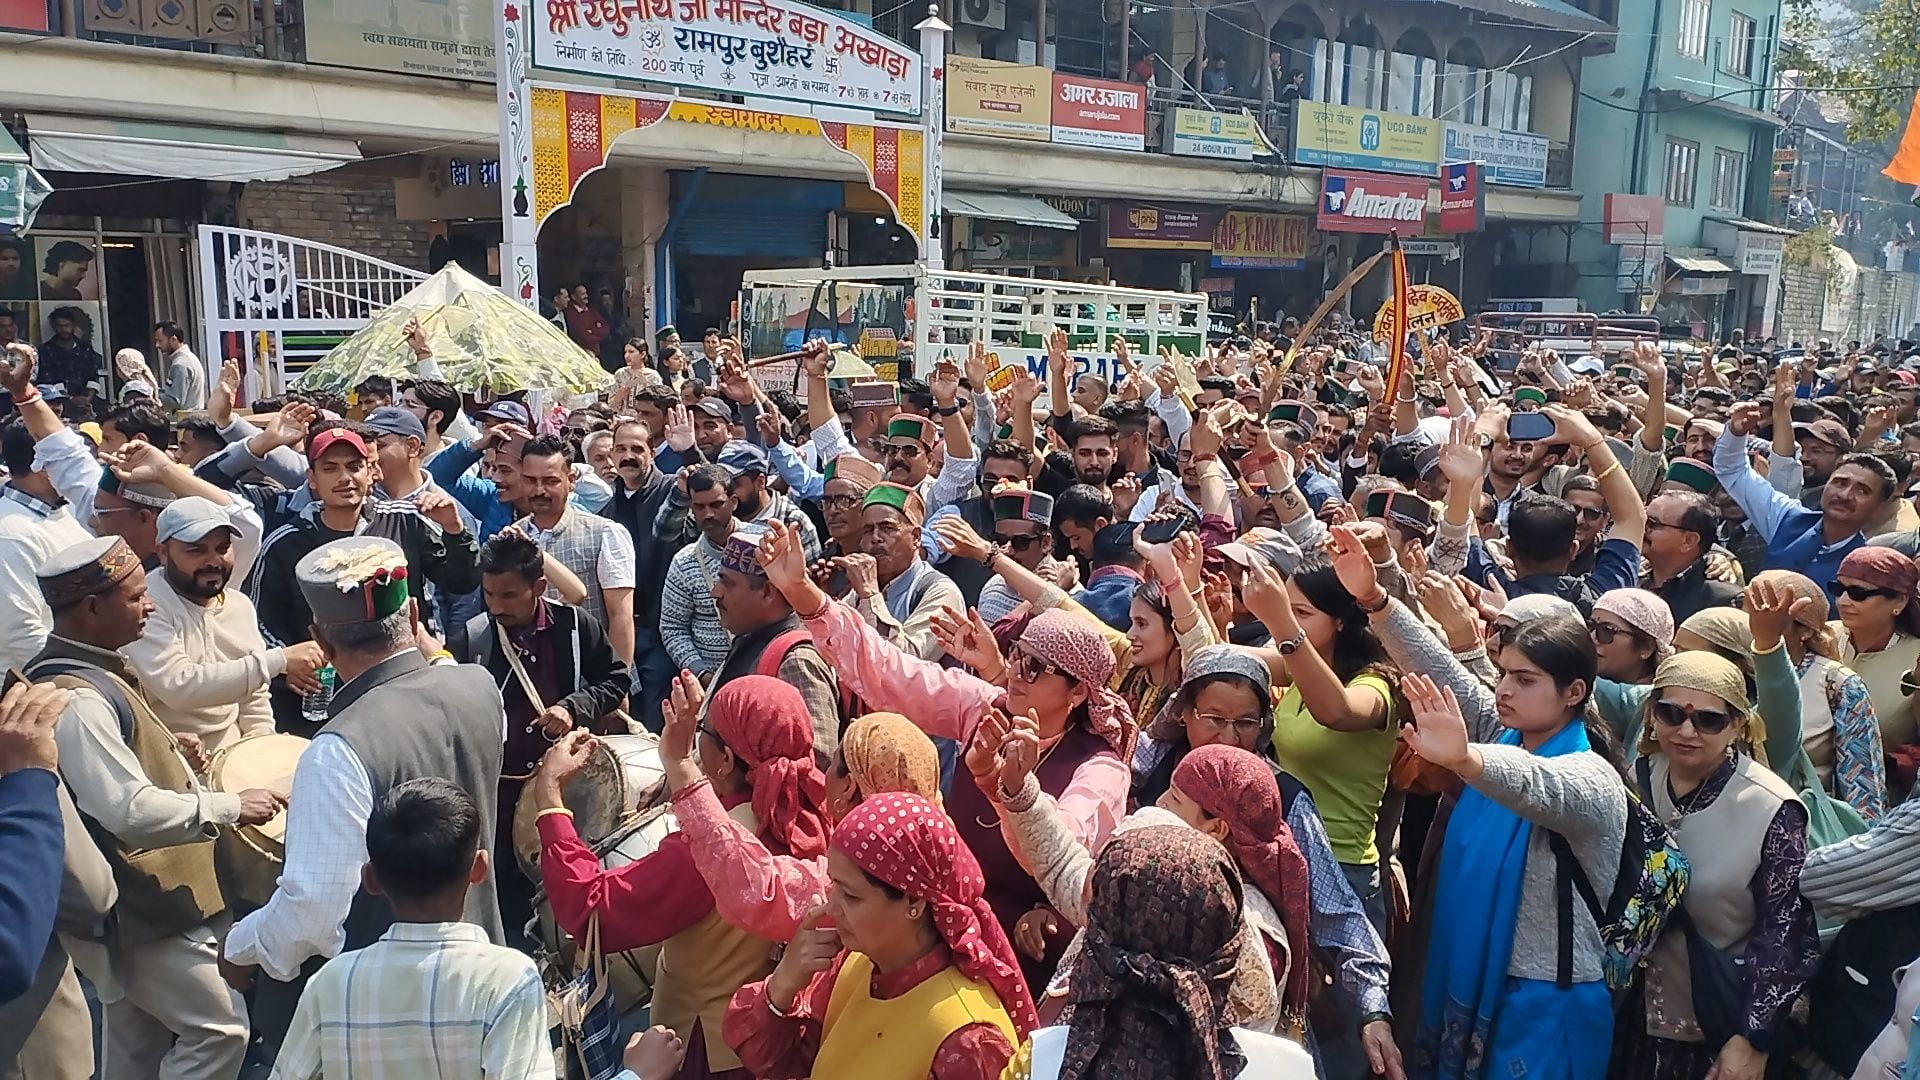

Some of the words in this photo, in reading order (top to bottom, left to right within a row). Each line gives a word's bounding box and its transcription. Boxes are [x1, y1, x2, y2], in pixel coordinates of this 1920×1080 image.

[387, 35, 428, 50] सहायता
[673, 26, 748, 66] रामपुर
[750, 37, 815, 70] बुशैहर
[553, 40, 587, 62] निर्माण
[642, 57, 667, 73] 200
[669, 57, 686, 74] वर्ष
[688, 60, 706, 80] पूर्व
[833, 25, 911, 83] अखाड़ा
[838, 85, 847, 98] 7
[883, 90, 891, 103] 7
[965, 79, 987, 93] संवाद
[1387, 121, 1404, 134] UCO
[1406, 123, 1428, 136] BANK
[1192, 143, 1201, 153] 24
[1202, 145, 1221, 154] HOUR
[1223, 146, 1236, 155] ATM
[1344, 187, 1426, 222] Amartex
[1441, 198, 1475, 210] Amartex
[1283, 218, 1305, 254] ECG
